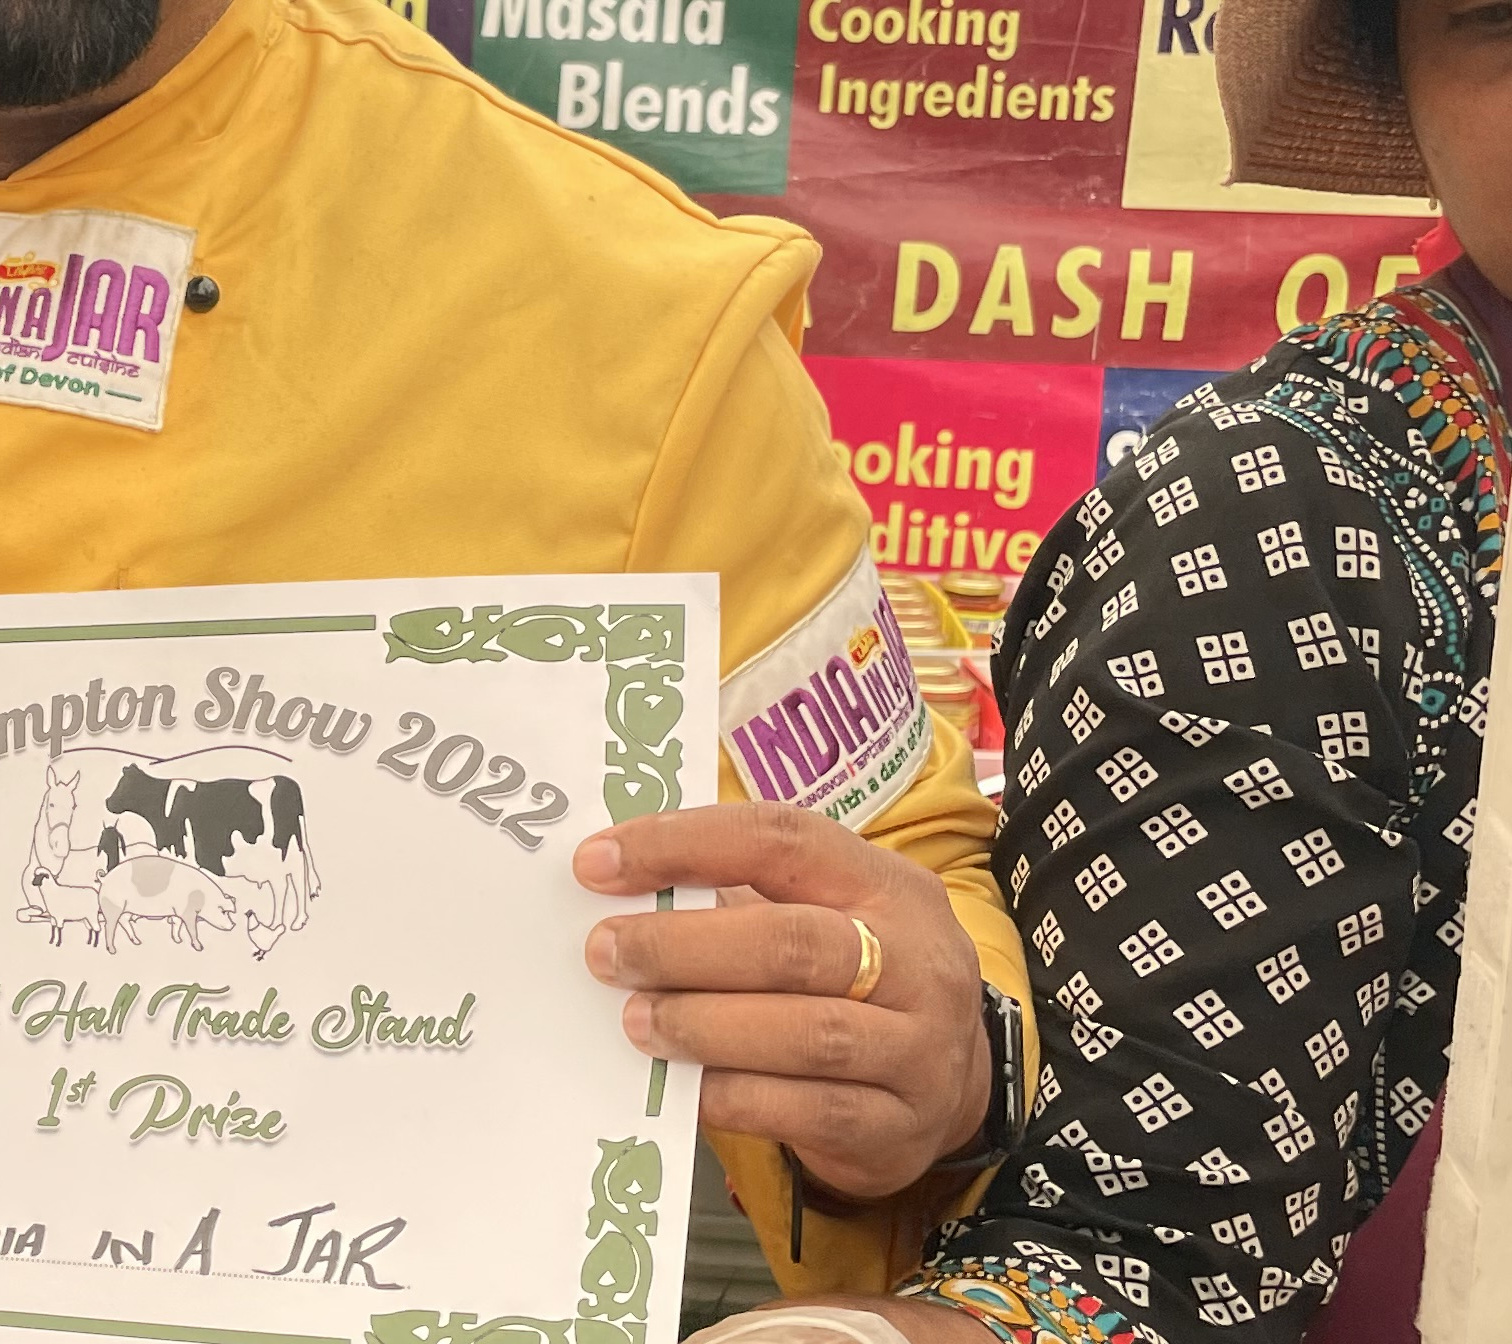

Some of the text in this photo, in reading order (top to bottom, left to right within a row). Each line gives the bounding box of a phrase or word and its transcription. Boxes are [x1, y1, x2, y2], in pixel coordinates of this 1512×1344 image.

[556, 62, 781, 137] Blends
[818, 65, 1116, 131] Ingredients
[21, 287, 52, 340] A
[42, 253, 170, 363] JAR
[890, 241, 1194, 342] DASH
[20, 369, 101, 398] Devon
[66, 350, 141, 378] cuisine
[193, 666, 374, 752] Show
[376, 711, 571, 852] 2022
[732, 656, 880, 801] INDIA
[10, 979, 140, 1043] Hall
[147, 983, 294, 1042] Trade
[311, 984, 477, 1051] Stand
[36, 1067, 288, 1143] 1st Prize
[92, 1229, 155, 1267] IN
[174, 1206, 221, 1276] A
[252, 1202, 408, 1290] JAR
